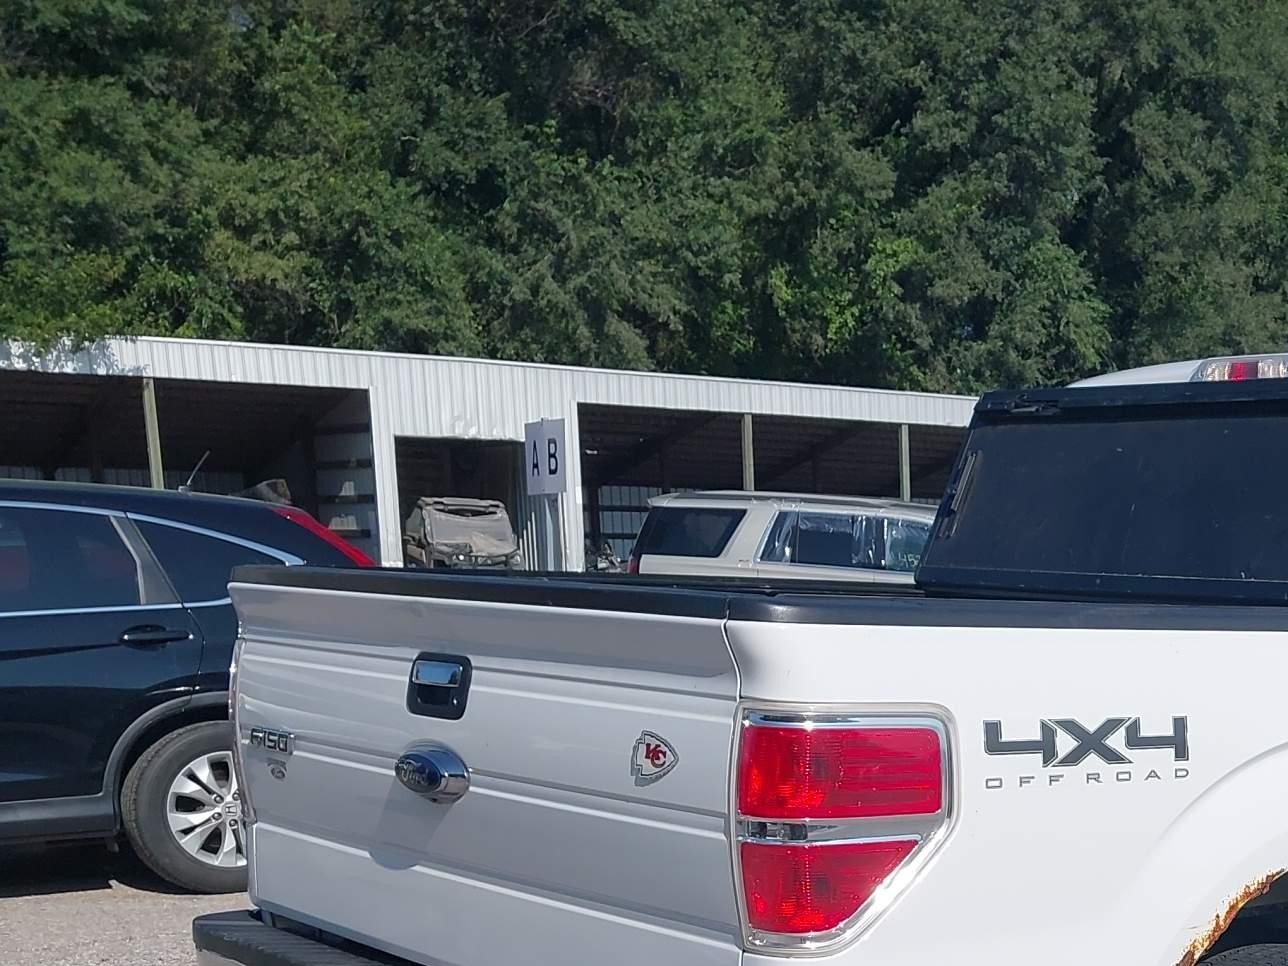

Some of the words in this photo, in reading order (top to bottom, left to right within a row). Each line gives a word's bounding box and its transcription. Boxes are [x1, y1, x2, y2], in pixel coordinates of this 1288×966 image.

[531, 439, 540, 477] A
[547, 438, 559, 475] B
[644, 742, 667, 769] KC
